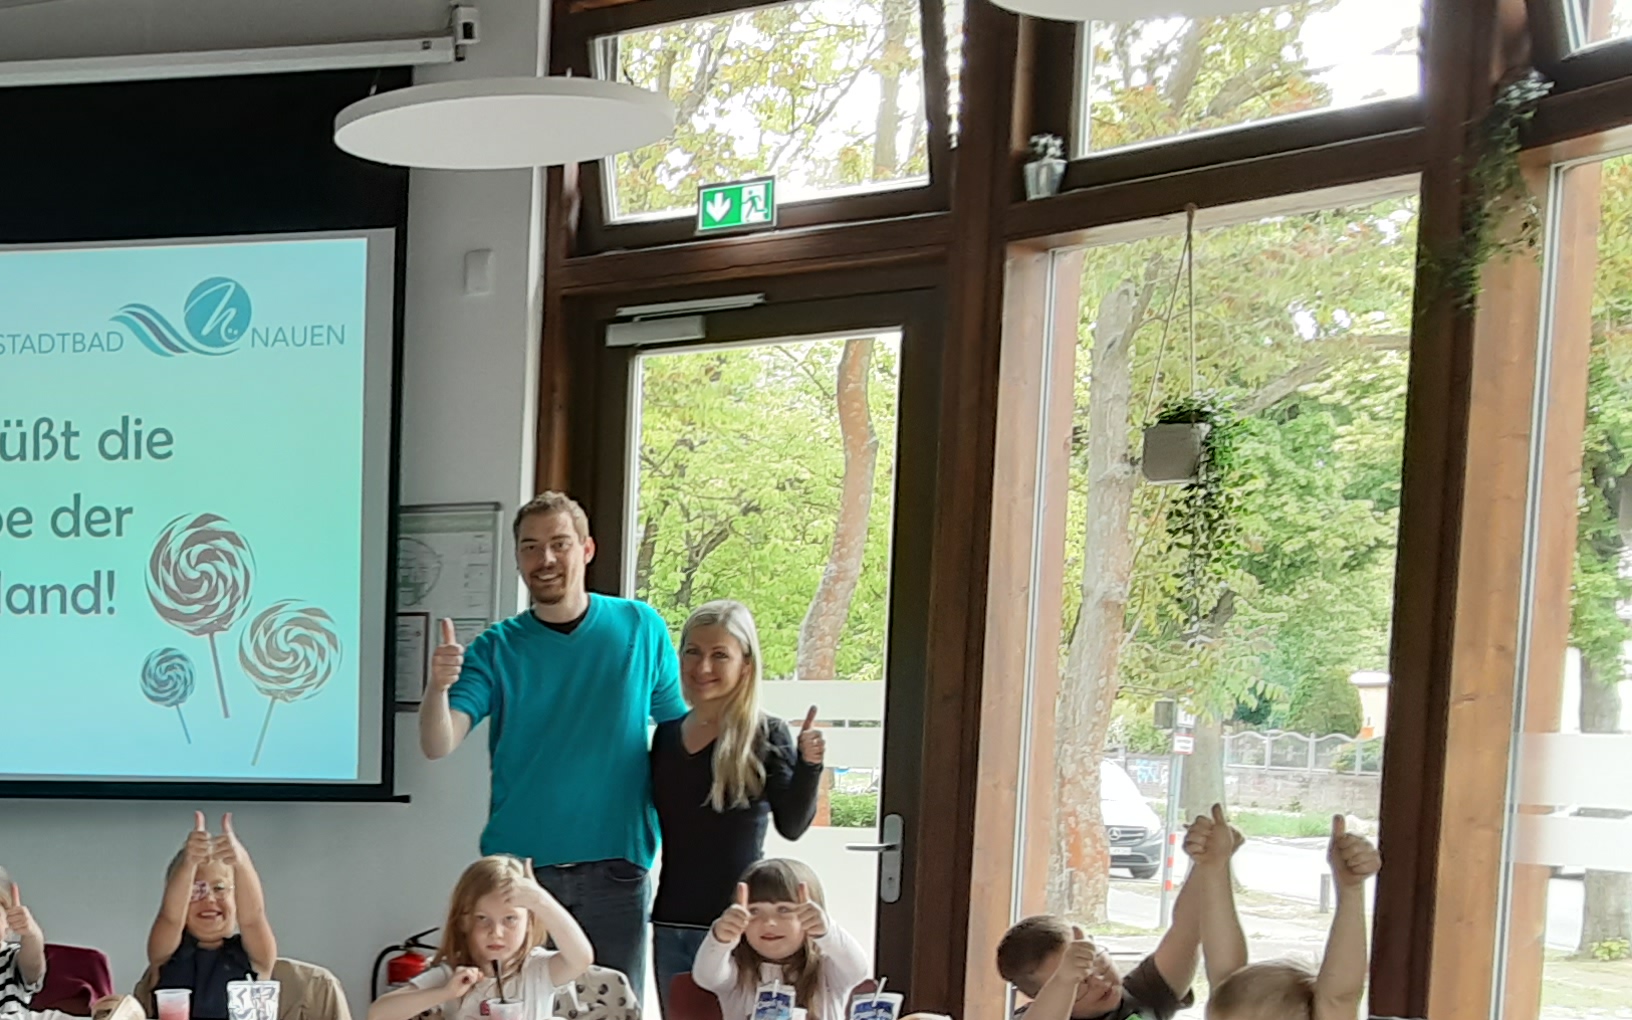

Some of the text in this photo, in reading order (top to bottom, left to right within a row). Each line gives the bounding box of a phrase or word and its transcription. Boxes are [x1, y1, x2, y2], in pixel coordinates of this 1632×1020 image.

[250, 324, 346, 349] NAUEN
[97, 415, 174, 462] die
[50, 492, 133, 539] der
